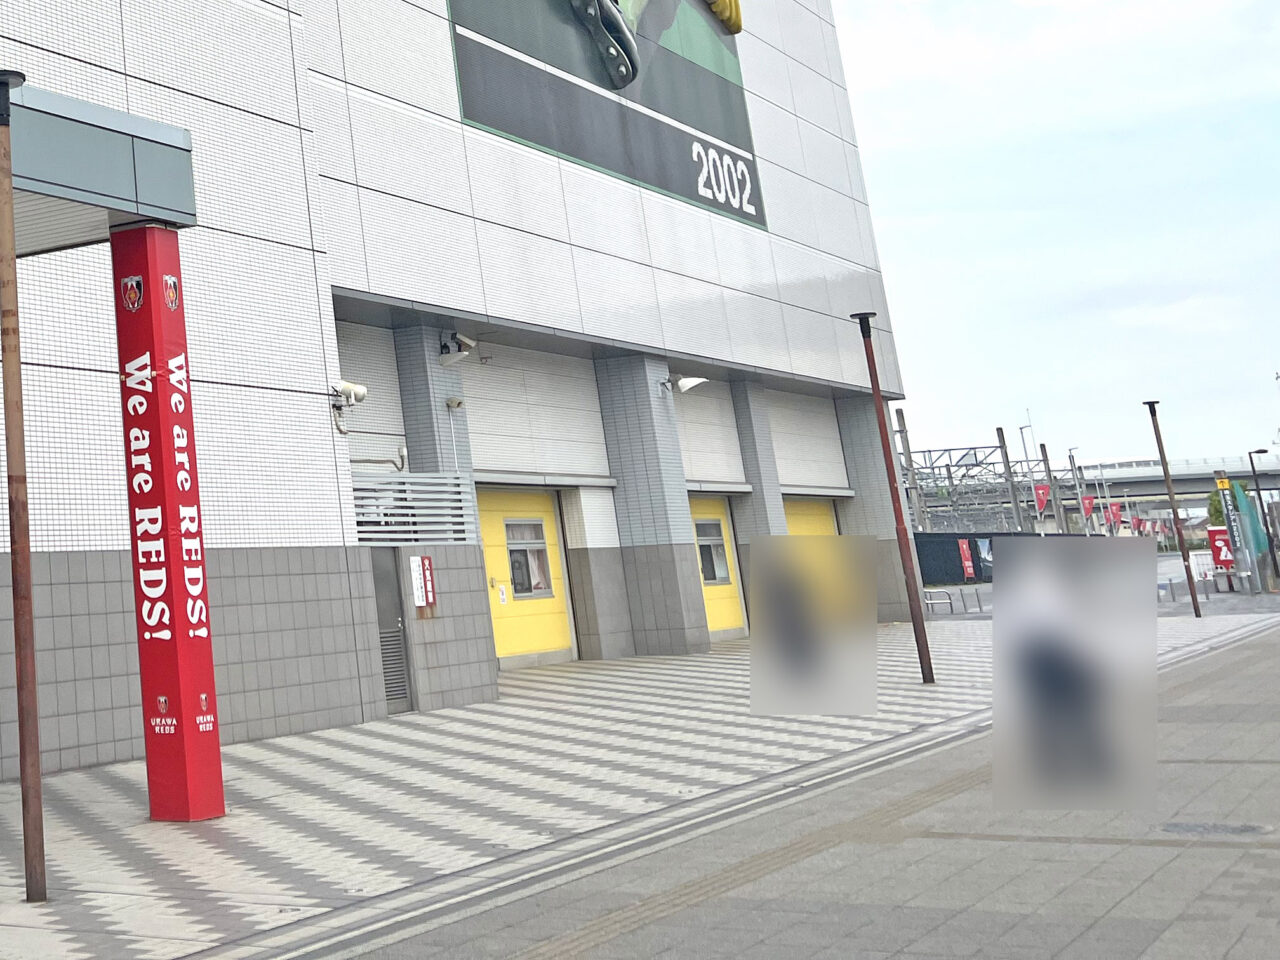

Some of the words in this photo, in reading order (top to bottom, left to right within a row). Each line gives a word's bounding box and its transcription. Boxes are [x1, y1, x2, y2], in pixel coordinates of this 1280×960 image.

[691, 141, 756, 216] 2002
[125, 351, 153, 416] We
[167, 352, 188, 414] We
[129, 427, 153, 494] are
[172, 424, 192, 492] are
[135, 505, 172, 640] REDS!
[179, 504, 209, 638] REDS!
[150, 717, 177, 726] URAWA
[154, 725, 175, 734] REDS
